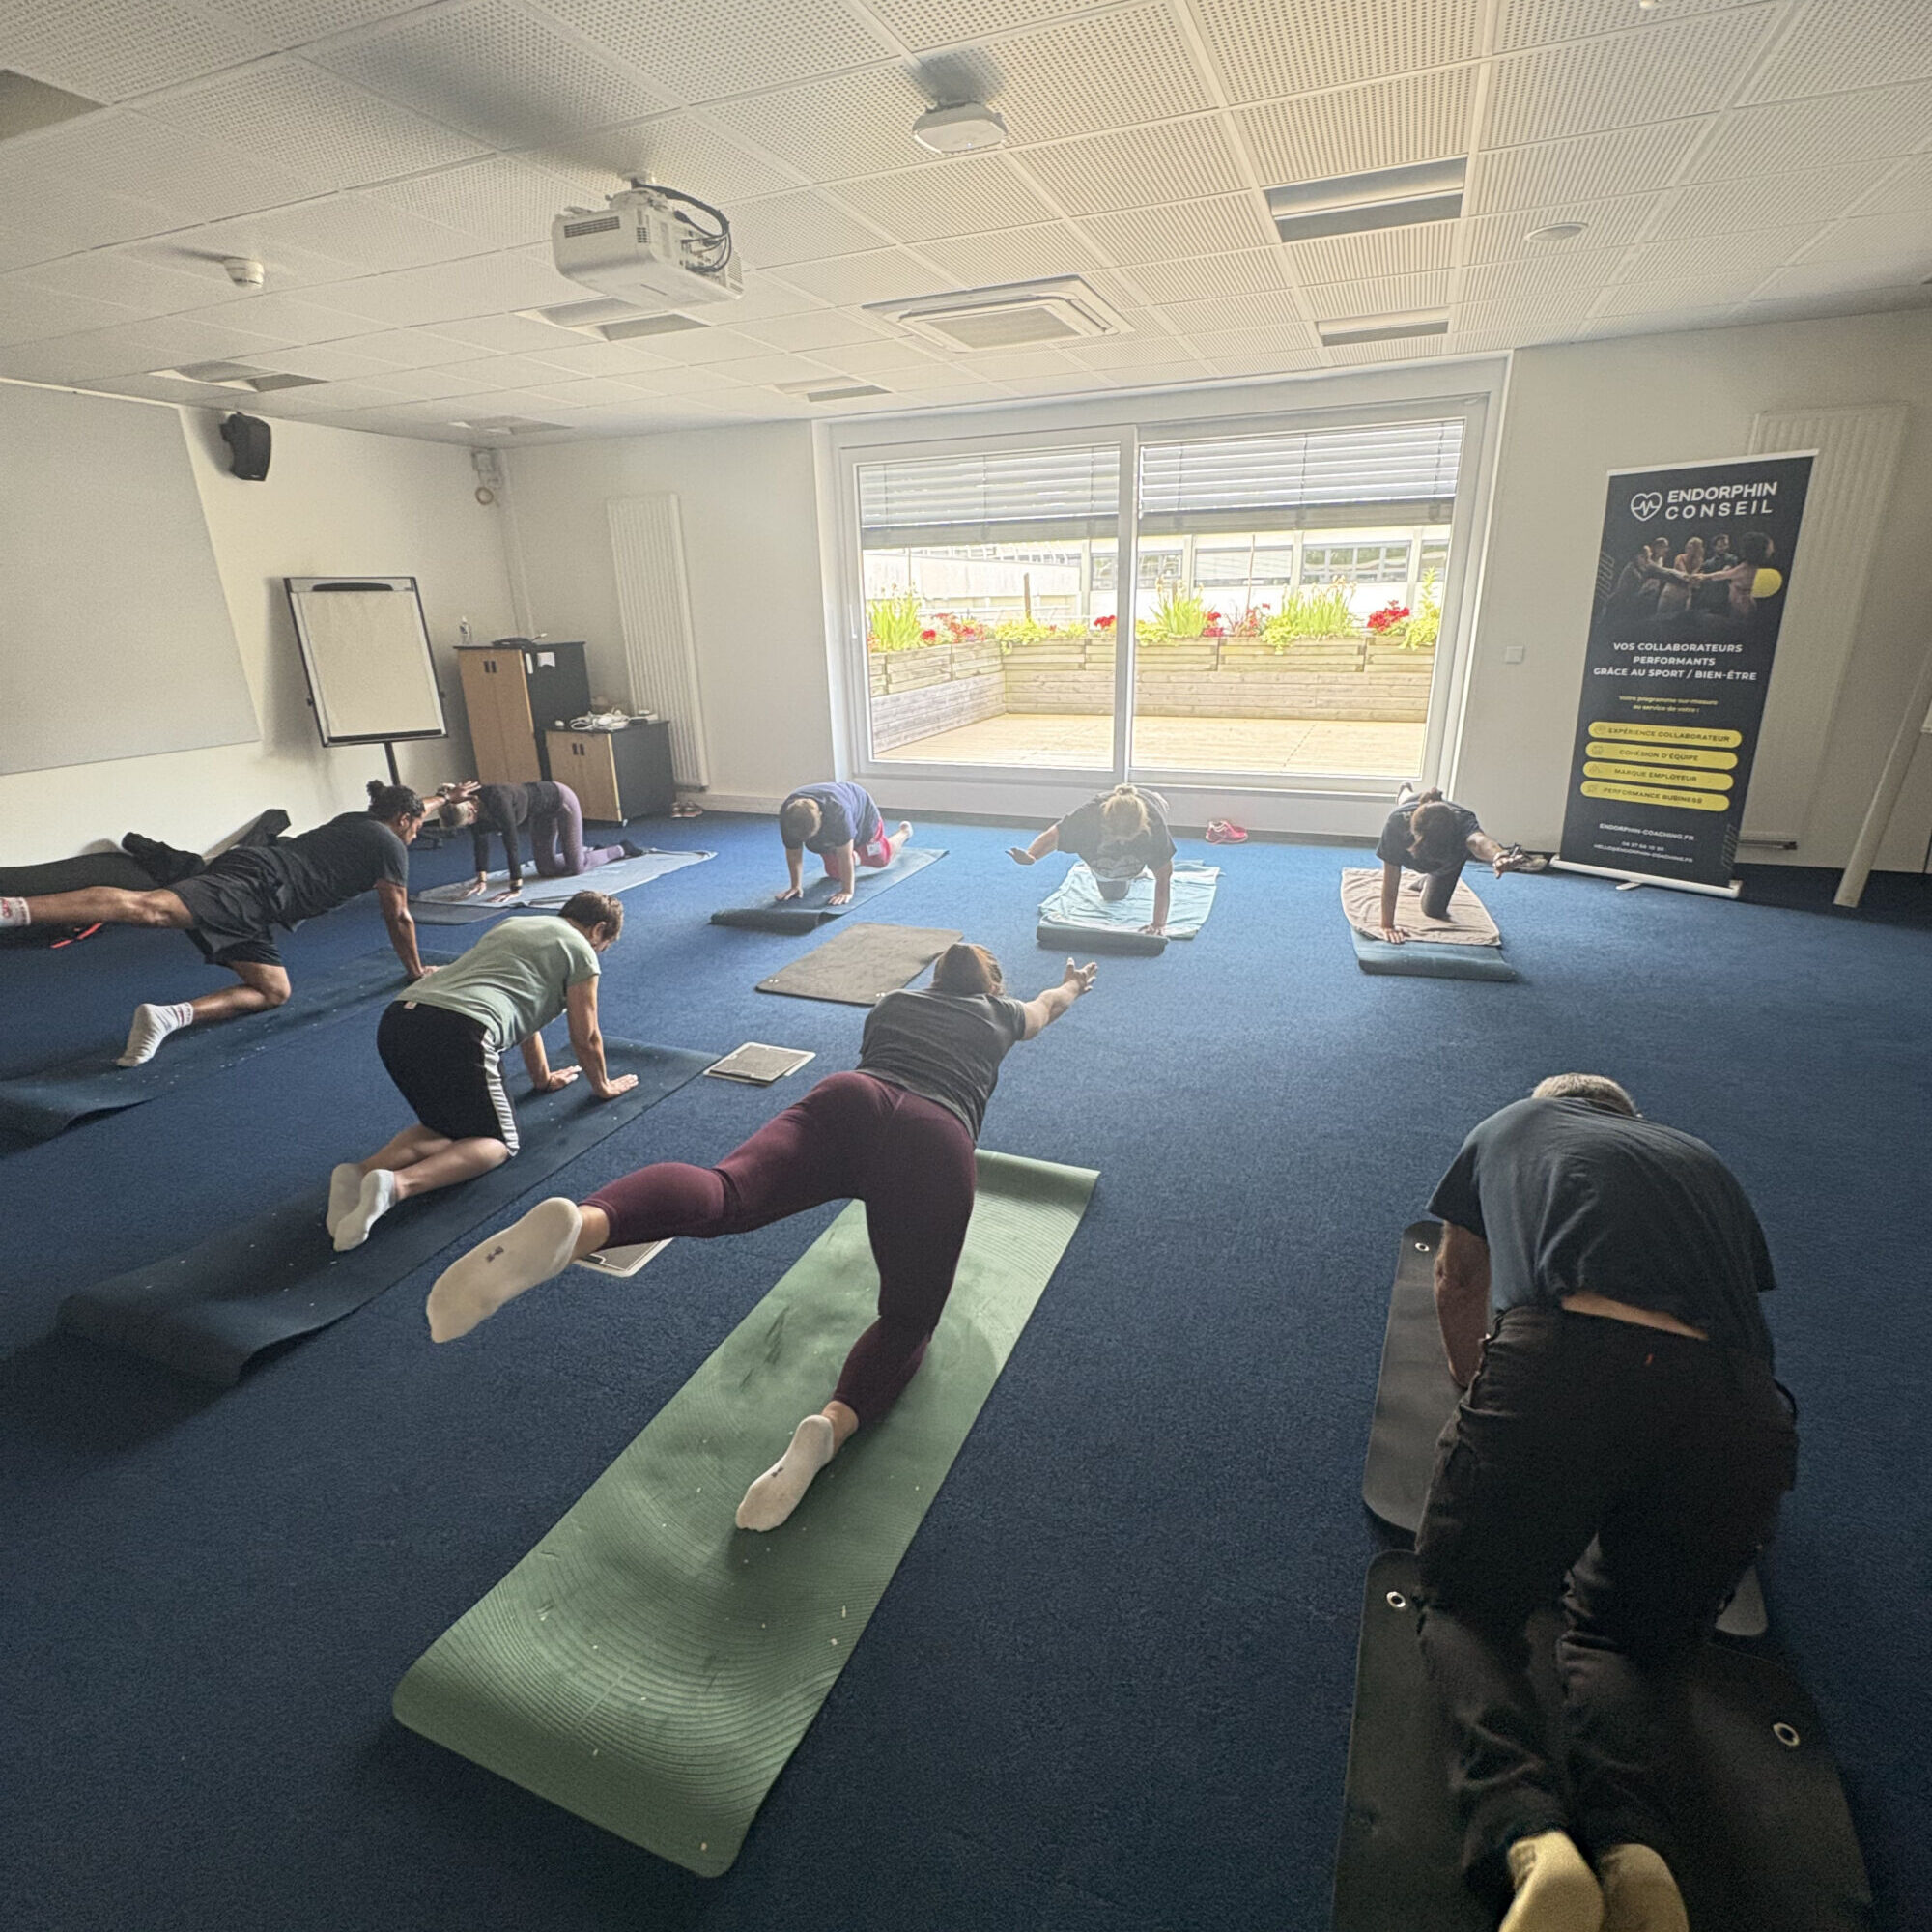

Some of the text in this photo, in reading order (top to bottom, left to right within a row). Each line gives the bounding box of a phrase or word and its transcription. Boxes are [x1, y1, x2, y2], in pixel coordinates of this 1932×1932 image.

[1667, 481, 1777, 503] ENDORPHIN
[1665, 499, 1773, 520] CONSEIL
[1613, 642, 1743, 653] VOS COLLABORATEURS
[1633, 656, 1716, 666] PERFORMANTS
[1593, 667, 1628, 676] GRÂCE
[1648, 669, 1685, 678] SPORT
[1695, 669, 1757, 681] BIEN-ÊTRE
[1608, 726, 1730, 742] EXPÉRIENCE COLLABORATEUR
[1619, 748, 1699, 761] COHÉSION D'ÉQUIPE
[1614, 768, 1697, 781] MARQUE EMPLOYEUR
[1603, 787, 1703, 804] PERFORMANCE BUSINESS
